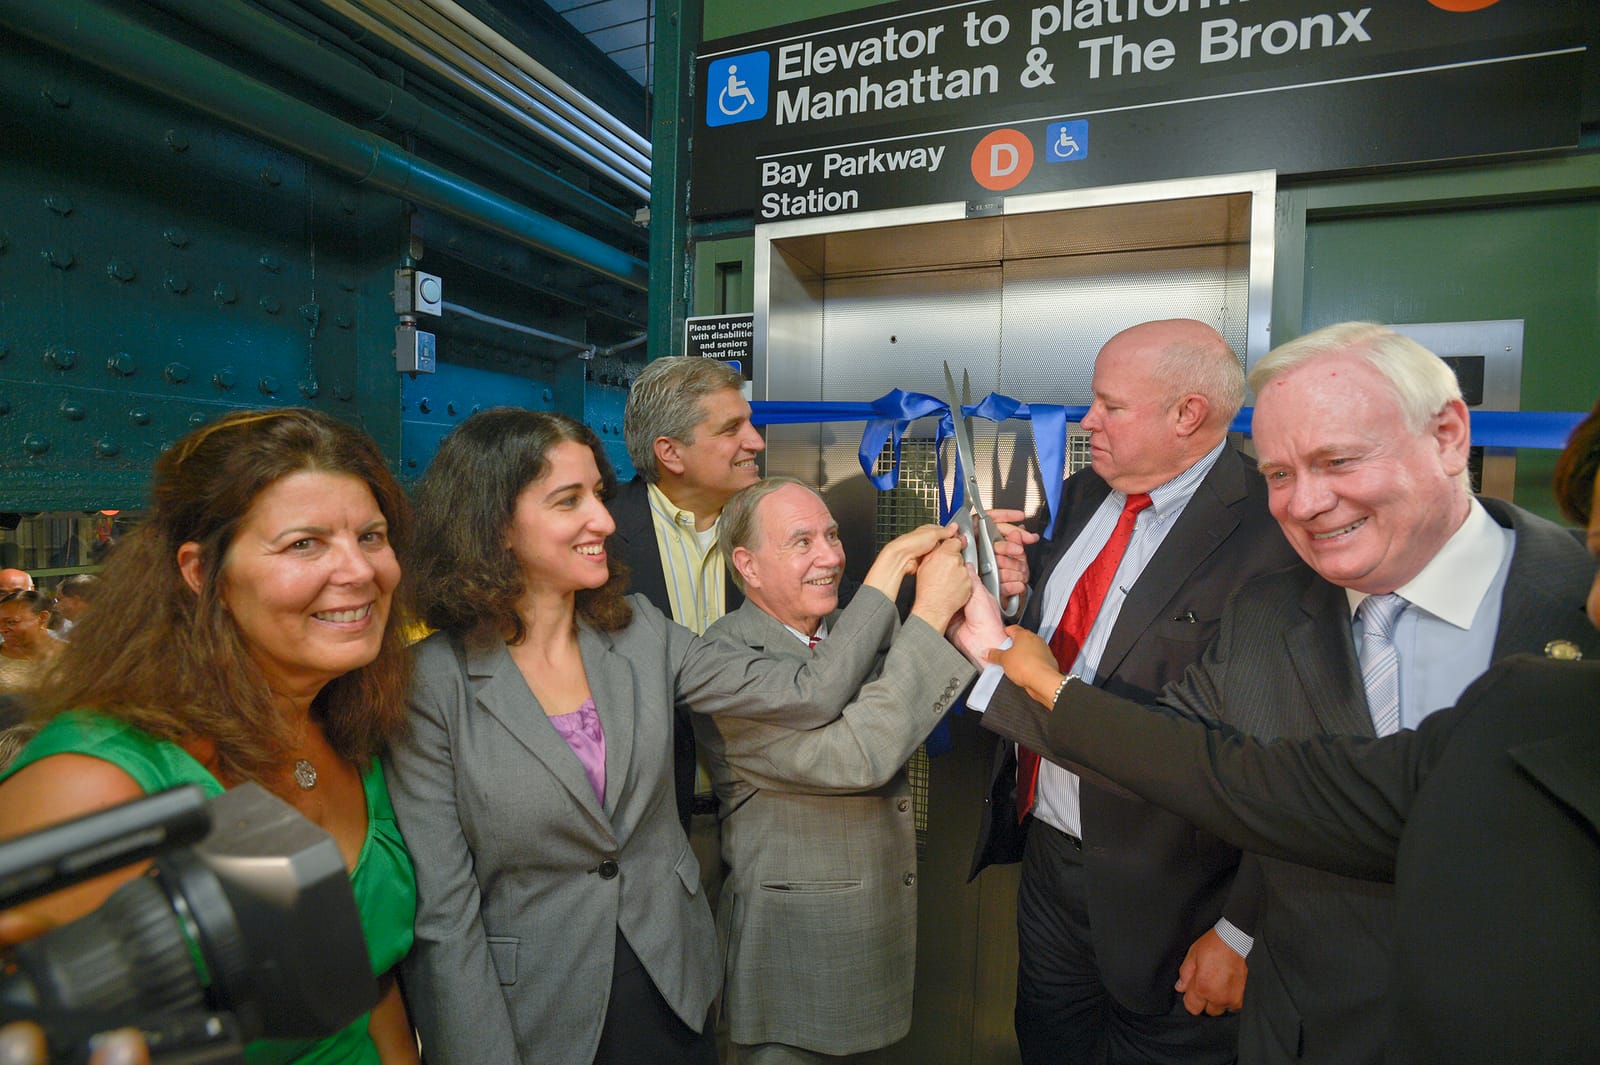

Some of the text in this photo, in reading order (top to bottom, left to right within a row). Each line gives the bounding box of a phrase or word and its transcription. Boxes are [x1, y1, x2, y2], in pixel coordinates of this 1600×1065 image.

[777, 0, 1252, 81] Elevator to plato
[775, 8, 1373, 126] Manhattan & The Bronx
[761, 145, 946, 188] Bay Parkway
[990, 143, 1019, 177] D
[760, 189, 859, 219] Station
[689, 321, 753, 332] Please let peop
[691, 330, 753, 341] with disabilitie
[699, 341, 748, 350] and seniors
[702, 349, 748, 358] board first.
